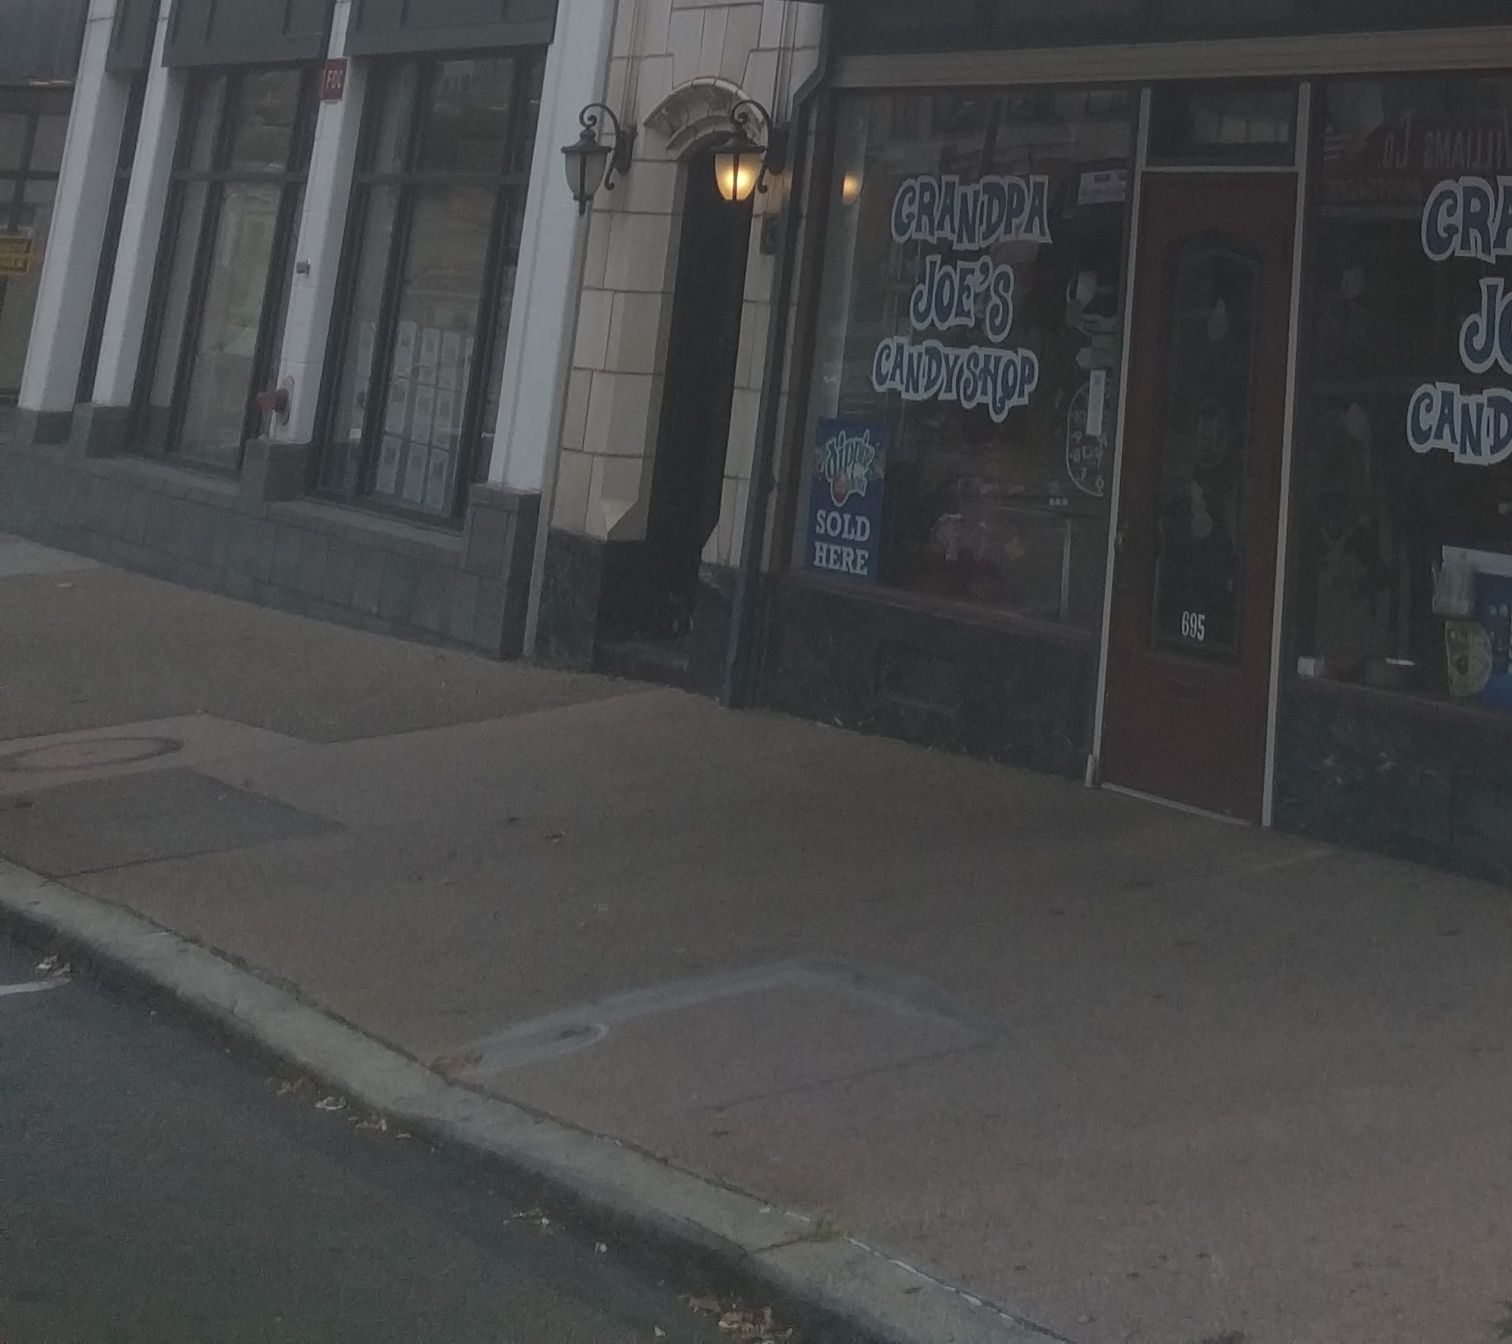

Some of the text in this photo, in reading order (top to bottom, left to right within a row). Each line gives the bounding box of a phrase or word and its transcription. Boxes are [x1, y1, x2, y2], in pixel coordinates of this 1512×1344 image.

[891, 174, 1053, 250] GRANDPA
[910, 254, 1014, 342] JOE'S
[815, 509, 871, 542] SOLD
[813, 541, 869, 576] HERE
[1181, 610, 1206, 643] 695
